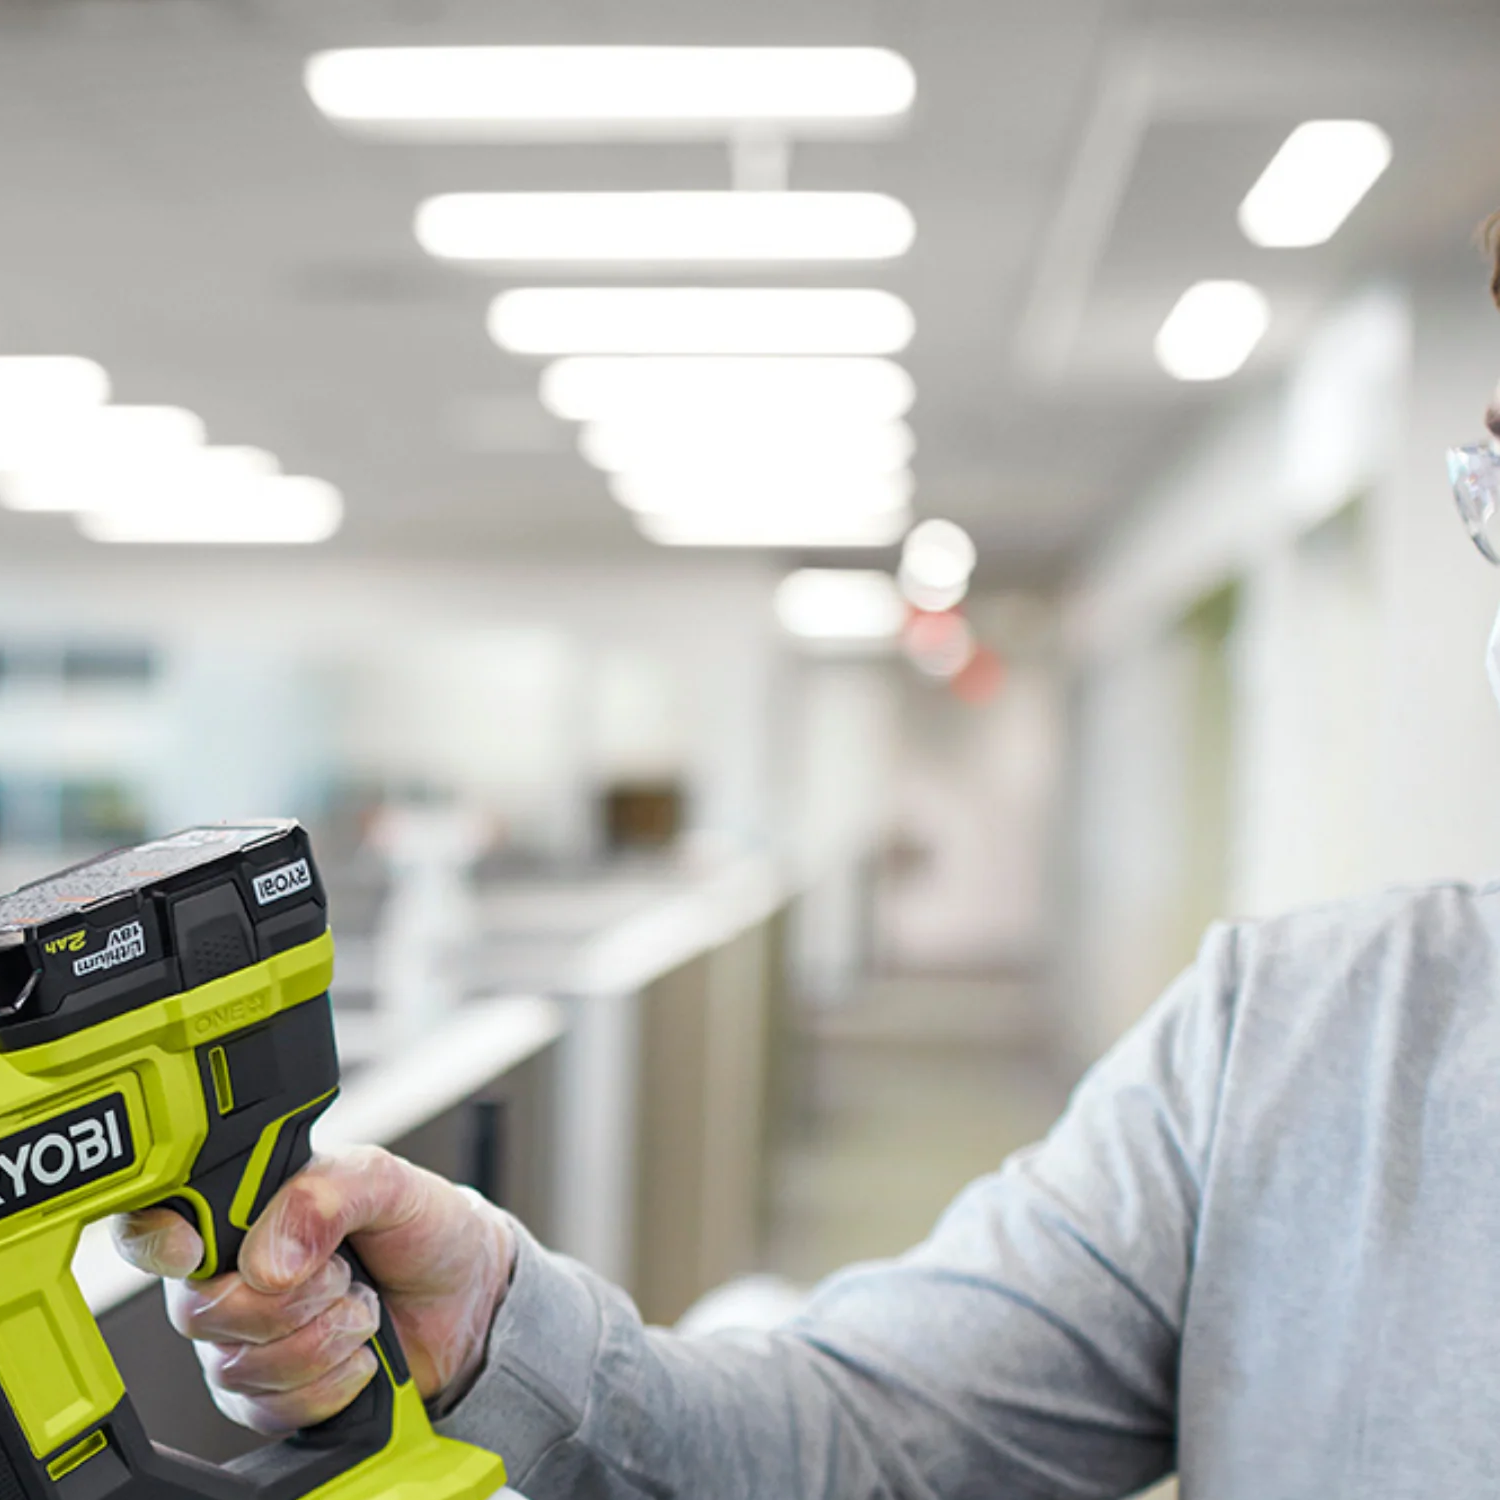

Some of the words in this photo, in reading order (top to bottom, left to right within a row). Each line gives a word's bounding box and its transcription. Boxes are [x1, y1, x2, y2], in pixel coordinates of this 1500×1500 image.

[257, 861, 309, 899] RYOBI
[45, 930, 87, 954] 2Ah
[109, 923, 140, 946] 18V
[74, 939, 143, 973] Lithium
